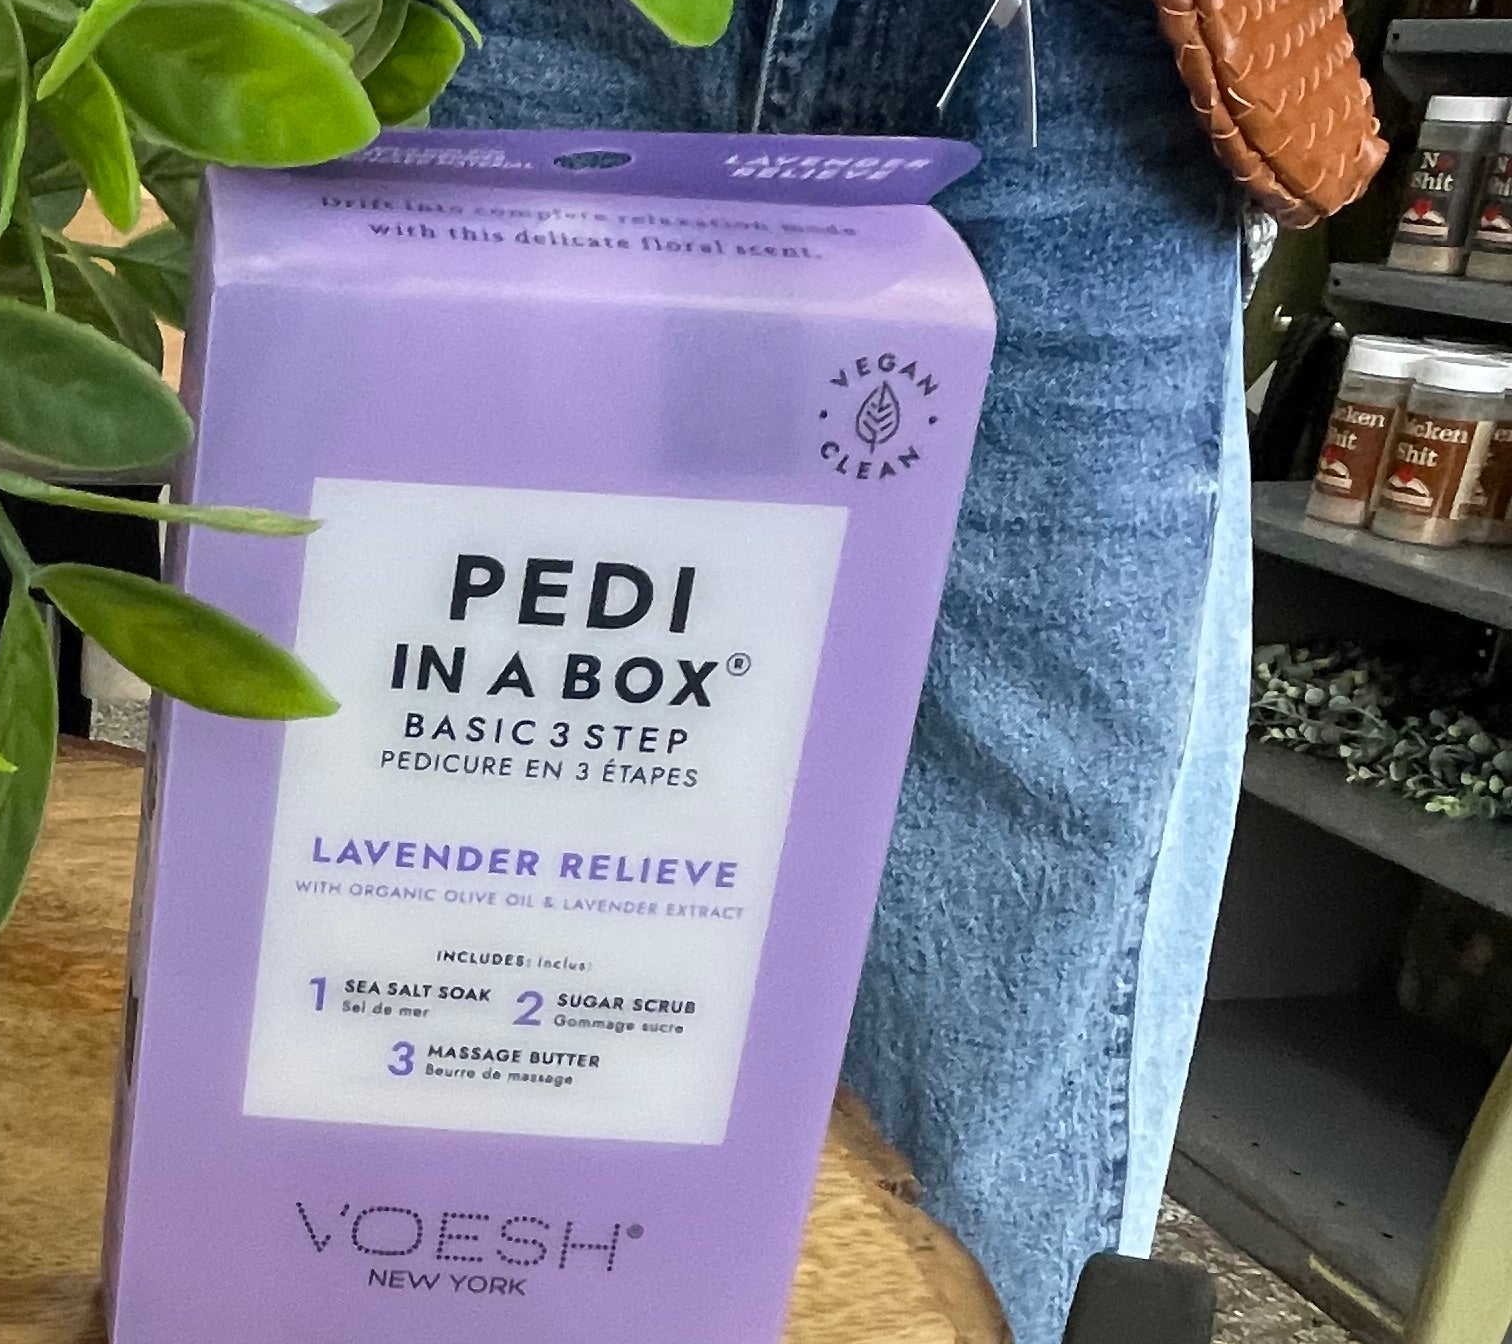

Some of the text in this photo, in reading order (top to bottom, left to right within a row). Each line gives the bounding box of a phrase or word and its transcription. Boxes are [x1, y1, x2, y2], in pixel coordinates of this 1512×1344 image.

[368, 223, 436, 239] with
[449, 226, 504, 242] this
[514, 227, 630, 250] delicate
[641, 236, 725, 254] floral
[829, 352, 940, 396] VEGAN
[820, 440, 921, 480] CLEAN
[1398, 441, 1440, 467] Shit
[448, 553, 696, 634] PEDI
[389, 643, 466, 694] IN
[488, 652, 535, 698] A
[404, 712, 690, 755] BASIC 3 STEP
[380, 750, 700, 789] PEDICURE EN 3 ÉTAPES
[311, 836, 739, 889] LAVENDER RELIEVE
[295, 879, 744, 921] WITH ORGANIC OLIVE OIL & LAVENDER EXTRACT
[309, 976, 696, 1026] 1 SEA SALT SOAK 2 SUGAR SCRUB
[342, 1000, 366, 1014] Sel
[372, 1002, 392, 1016] de
[399, 1006, 431, 1018] mer
[553, 1013, 635, 1034] Gommage
[388, 1040, 600, 1076] 3 MASSAGE BUTTER
[425, 1063, 573, 1087] Beurre de massage
[367, 1268, 527, 1297] NEW YORK
